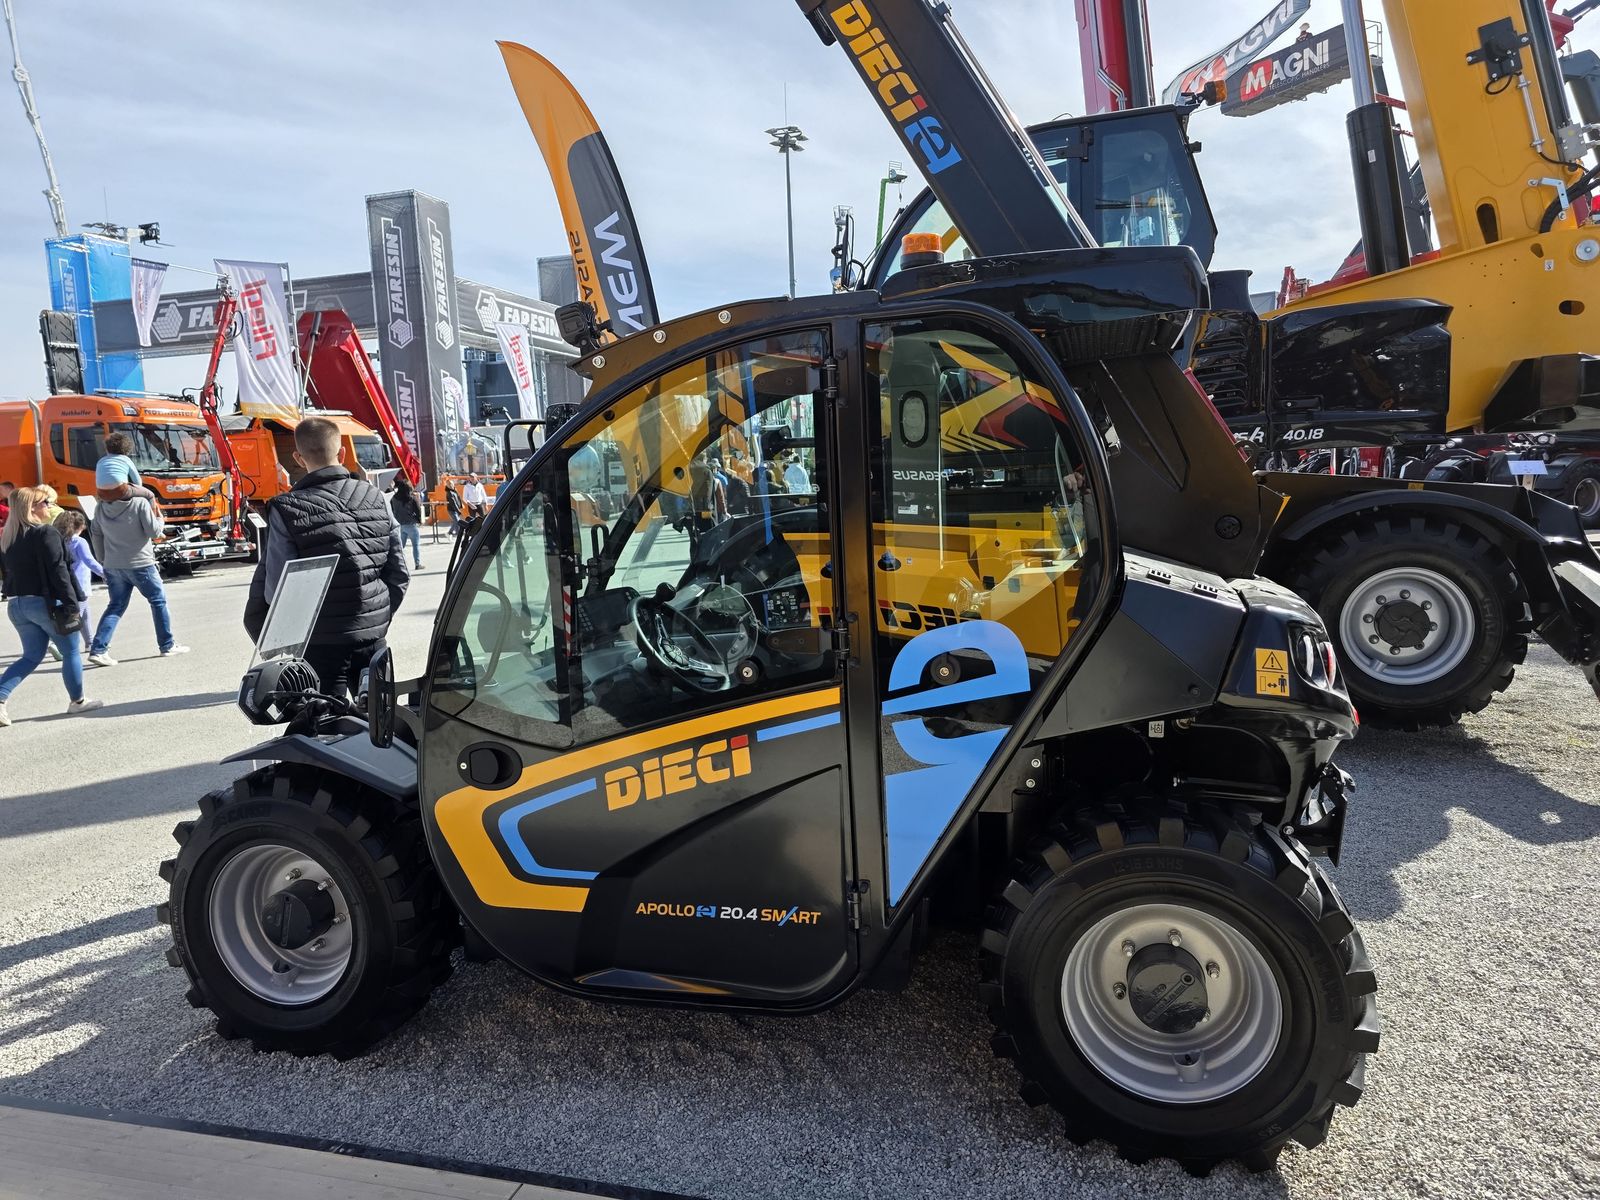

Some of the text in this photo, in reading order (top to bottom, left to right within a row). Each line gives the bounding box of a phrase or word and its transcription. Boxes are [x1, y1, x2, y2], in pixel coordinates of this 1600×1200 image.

[830, 0, 929, 122] DIECI
[1245, 39, 1330, 95] MAGNI
[385, 232, 405, 316] FARESIN
[431, 233, 449, 319] FARESIN
[1282, 428, 1325, 441] 40.18
[604, 734, 752, 811] DIECI
[636, 902, 695, 918] APOLLO
[719, 906, 759, 921] 20.4
